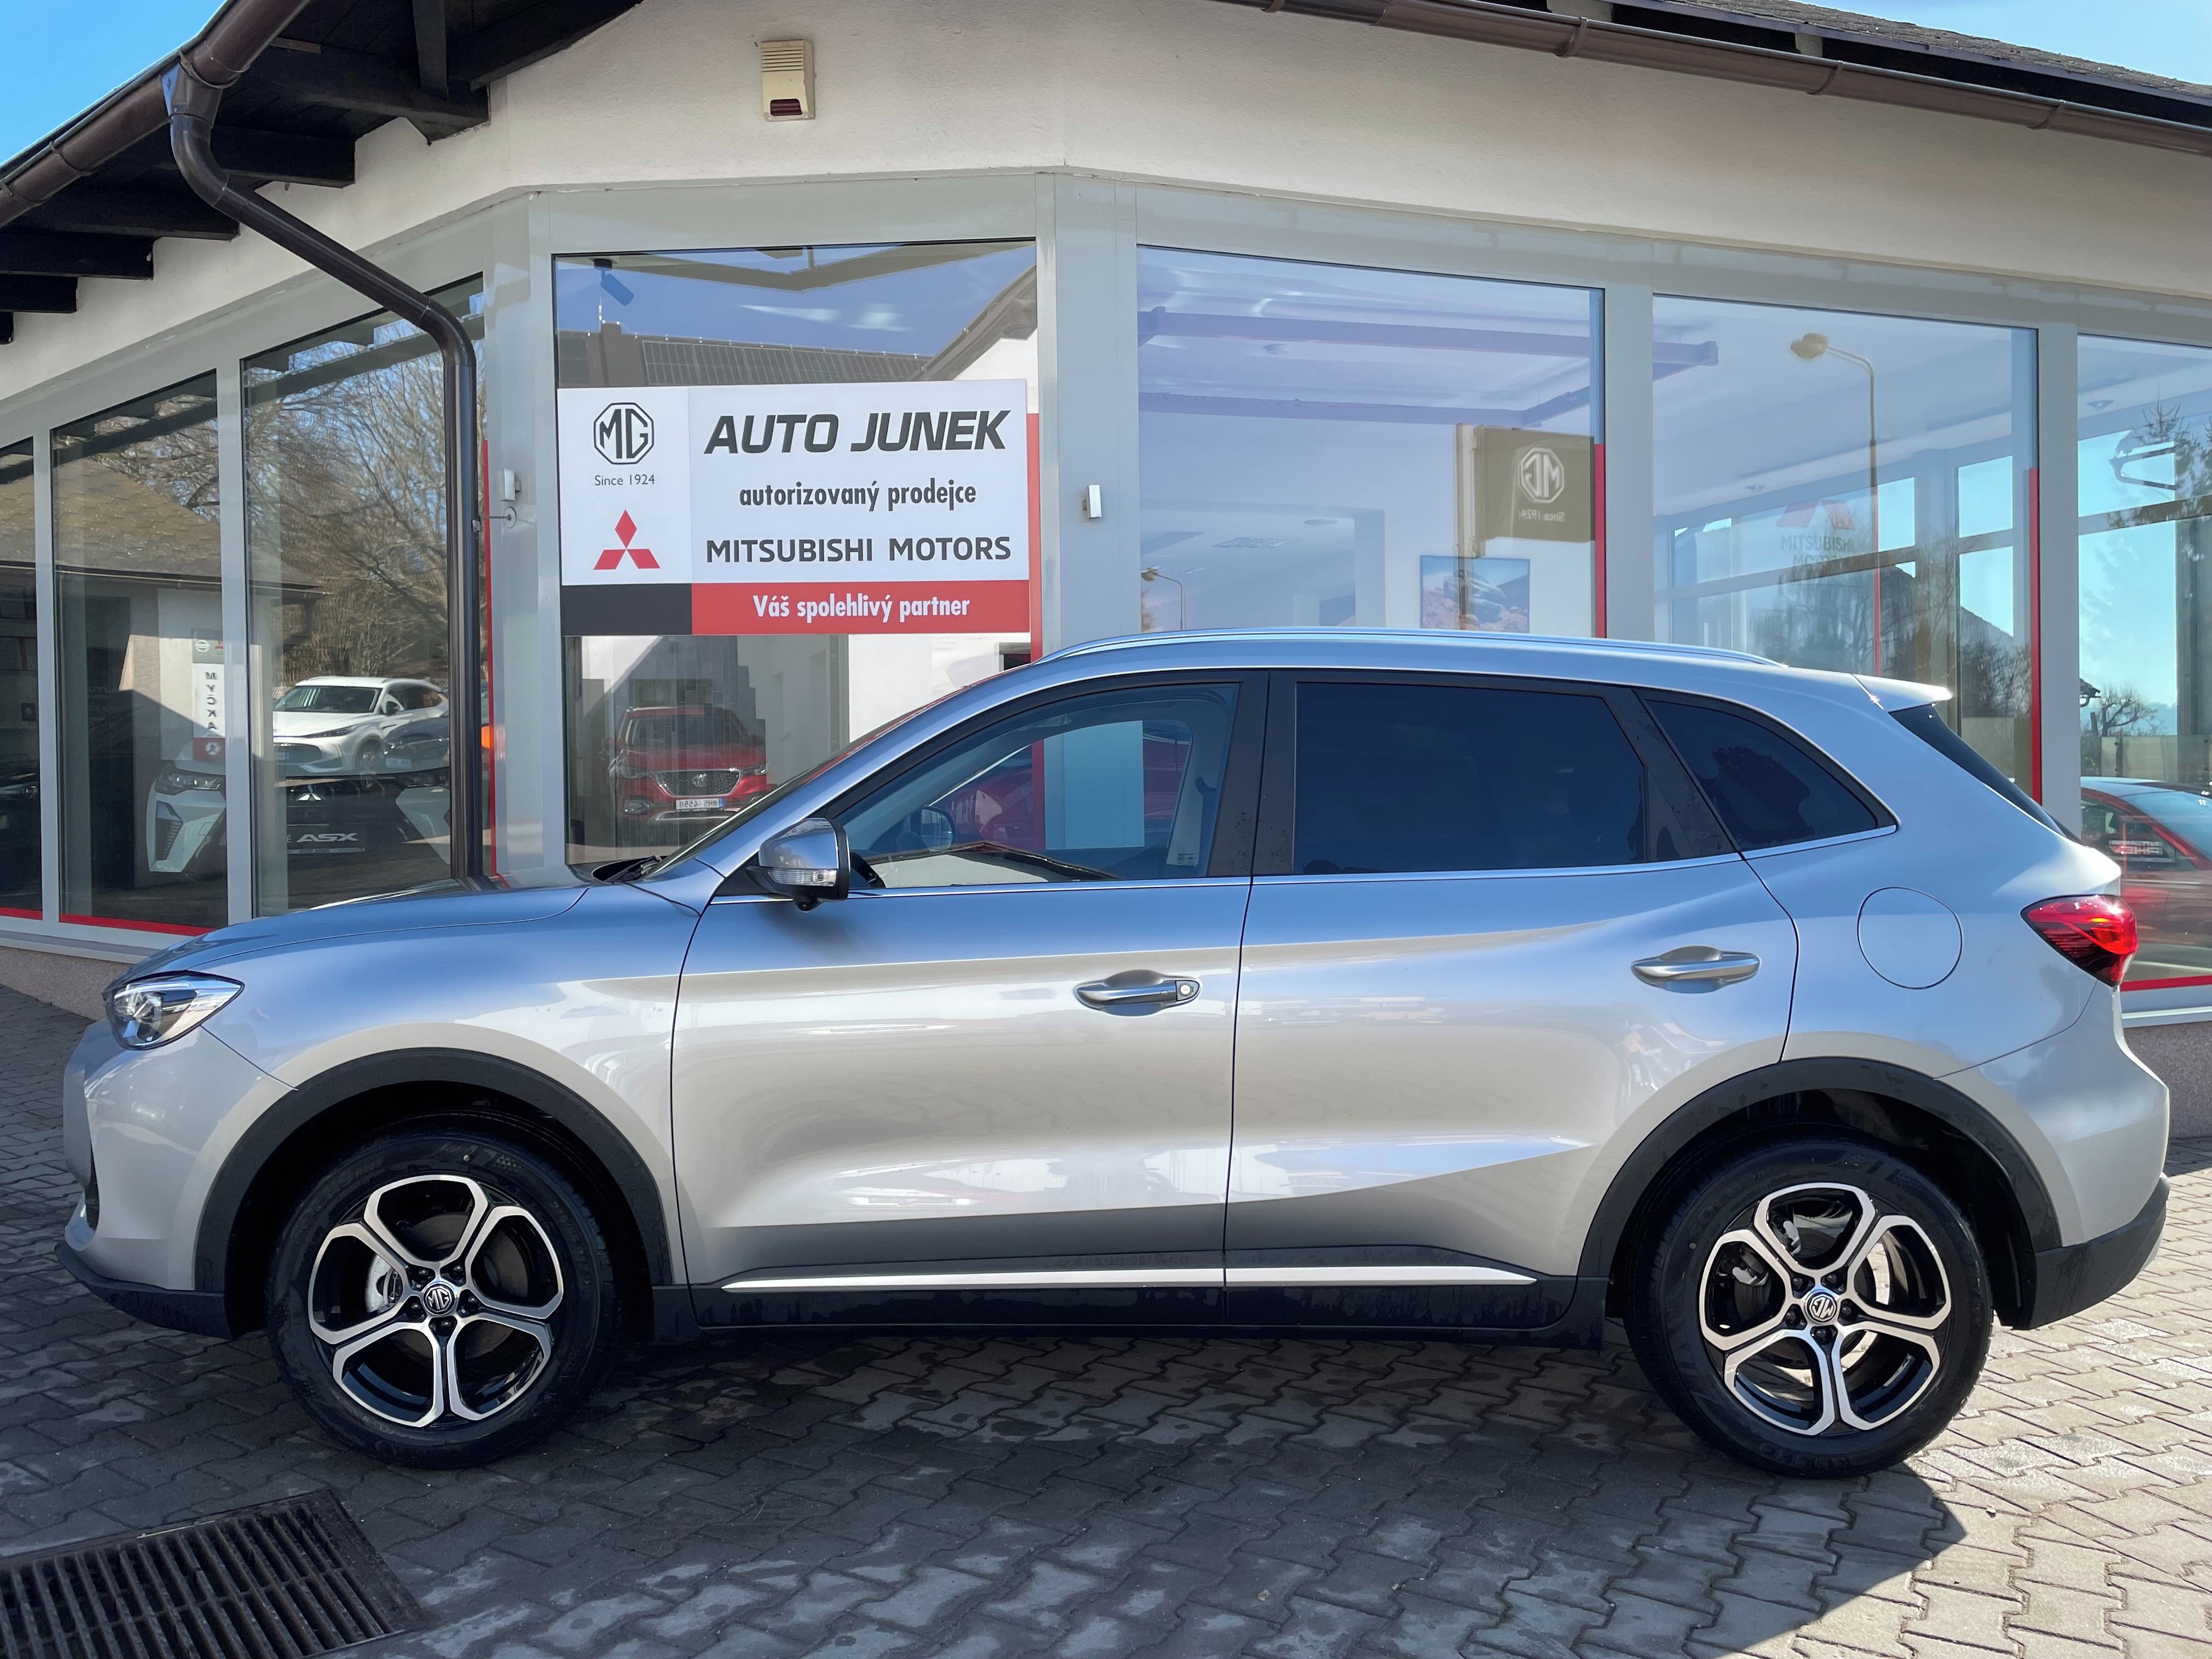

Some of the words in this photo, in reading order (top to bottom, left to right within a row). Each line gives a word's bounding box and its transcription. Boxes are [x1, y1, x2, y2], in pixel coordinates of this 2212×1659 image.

[597, 406, 651, 461] MG
[704, 414, 838, 454] AUTO
[850, 410, 1011, 452] JUNEK
[595, 475, 623, 486] Since
[629, 473, 655, 485] 1924
[740, 480, 879, 512] autorizovaný
[888, 477, 976, 512] prodejce
[707, 538, 872, 563] MITSUBISHI
[889, 536, 1011, 561] MOTORS
[753, 595, 789, 617] Váš
[797, 592, 893, 623] spolehlivý
[900, 596, 970, 623] partner
[296, 833, 358, 843] ASX
[426, 1288, 452, 1311] MG
[1810, 1295, 1835, 1319] MG
